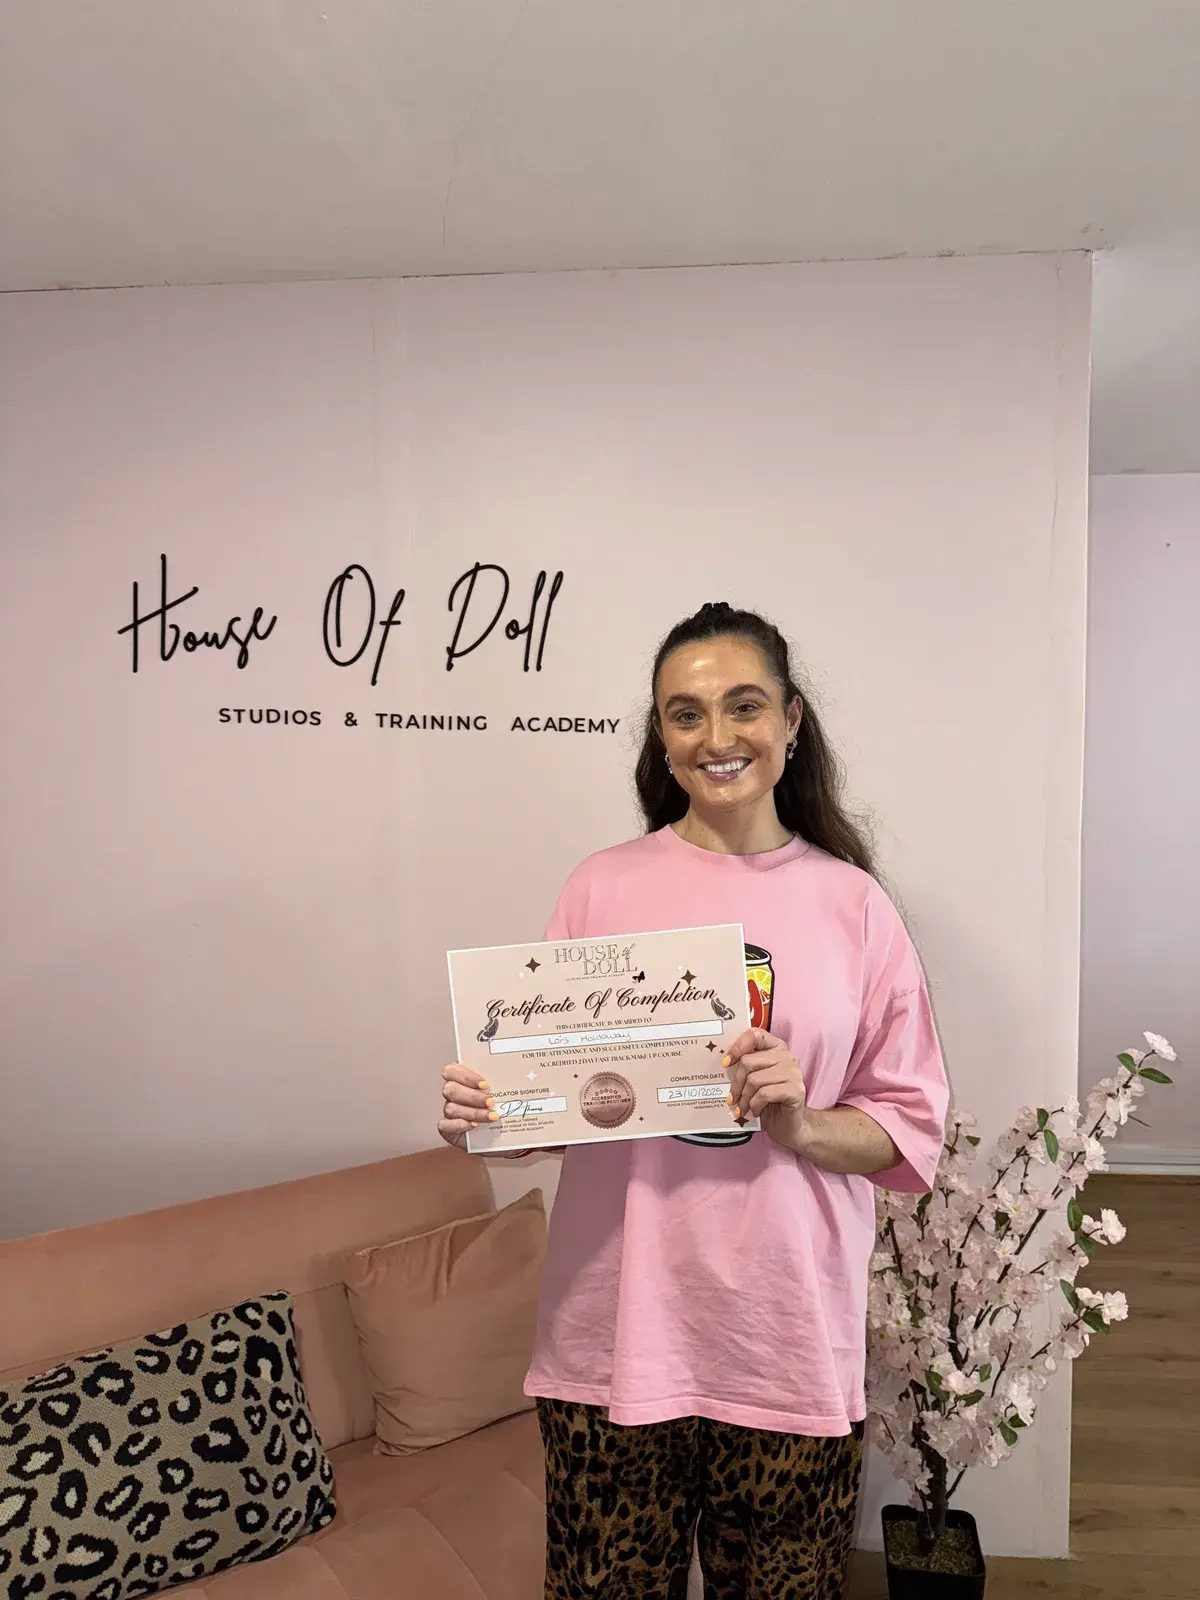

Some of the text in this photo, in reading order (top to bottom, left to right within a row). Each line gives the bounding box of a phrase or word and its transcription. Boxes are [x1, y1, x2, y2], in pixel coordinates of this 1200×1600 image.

[118, 554, 564, 686] House Of Doll
[218, 707, 621, 735] STUDIOS & TRAINING ACADEMY
[553, 944, 619, 963] HOUSE
[582, 958, 638, 975] DOLL
[486, 981, 717, 1025] Certificate Of Completion
[569, 1021, 606, 1029] CERTIFICATE
[549, 1047, 587, 1057] ATTENDANCE
[601, 1043, 639, 1052] SUCCESSFUL
[640, 1040, 681, 1049] COMPLETION
[539, 1059, 578, 1068] ACCREDITED
[611, 1054, 631, 1062] TRACK
[670, 1074, 709, 1082] COMPLETION
[520, 1088, 550, 1096] SIGNITURE
[668, 1088, 724, 1099] 23/10/2025
